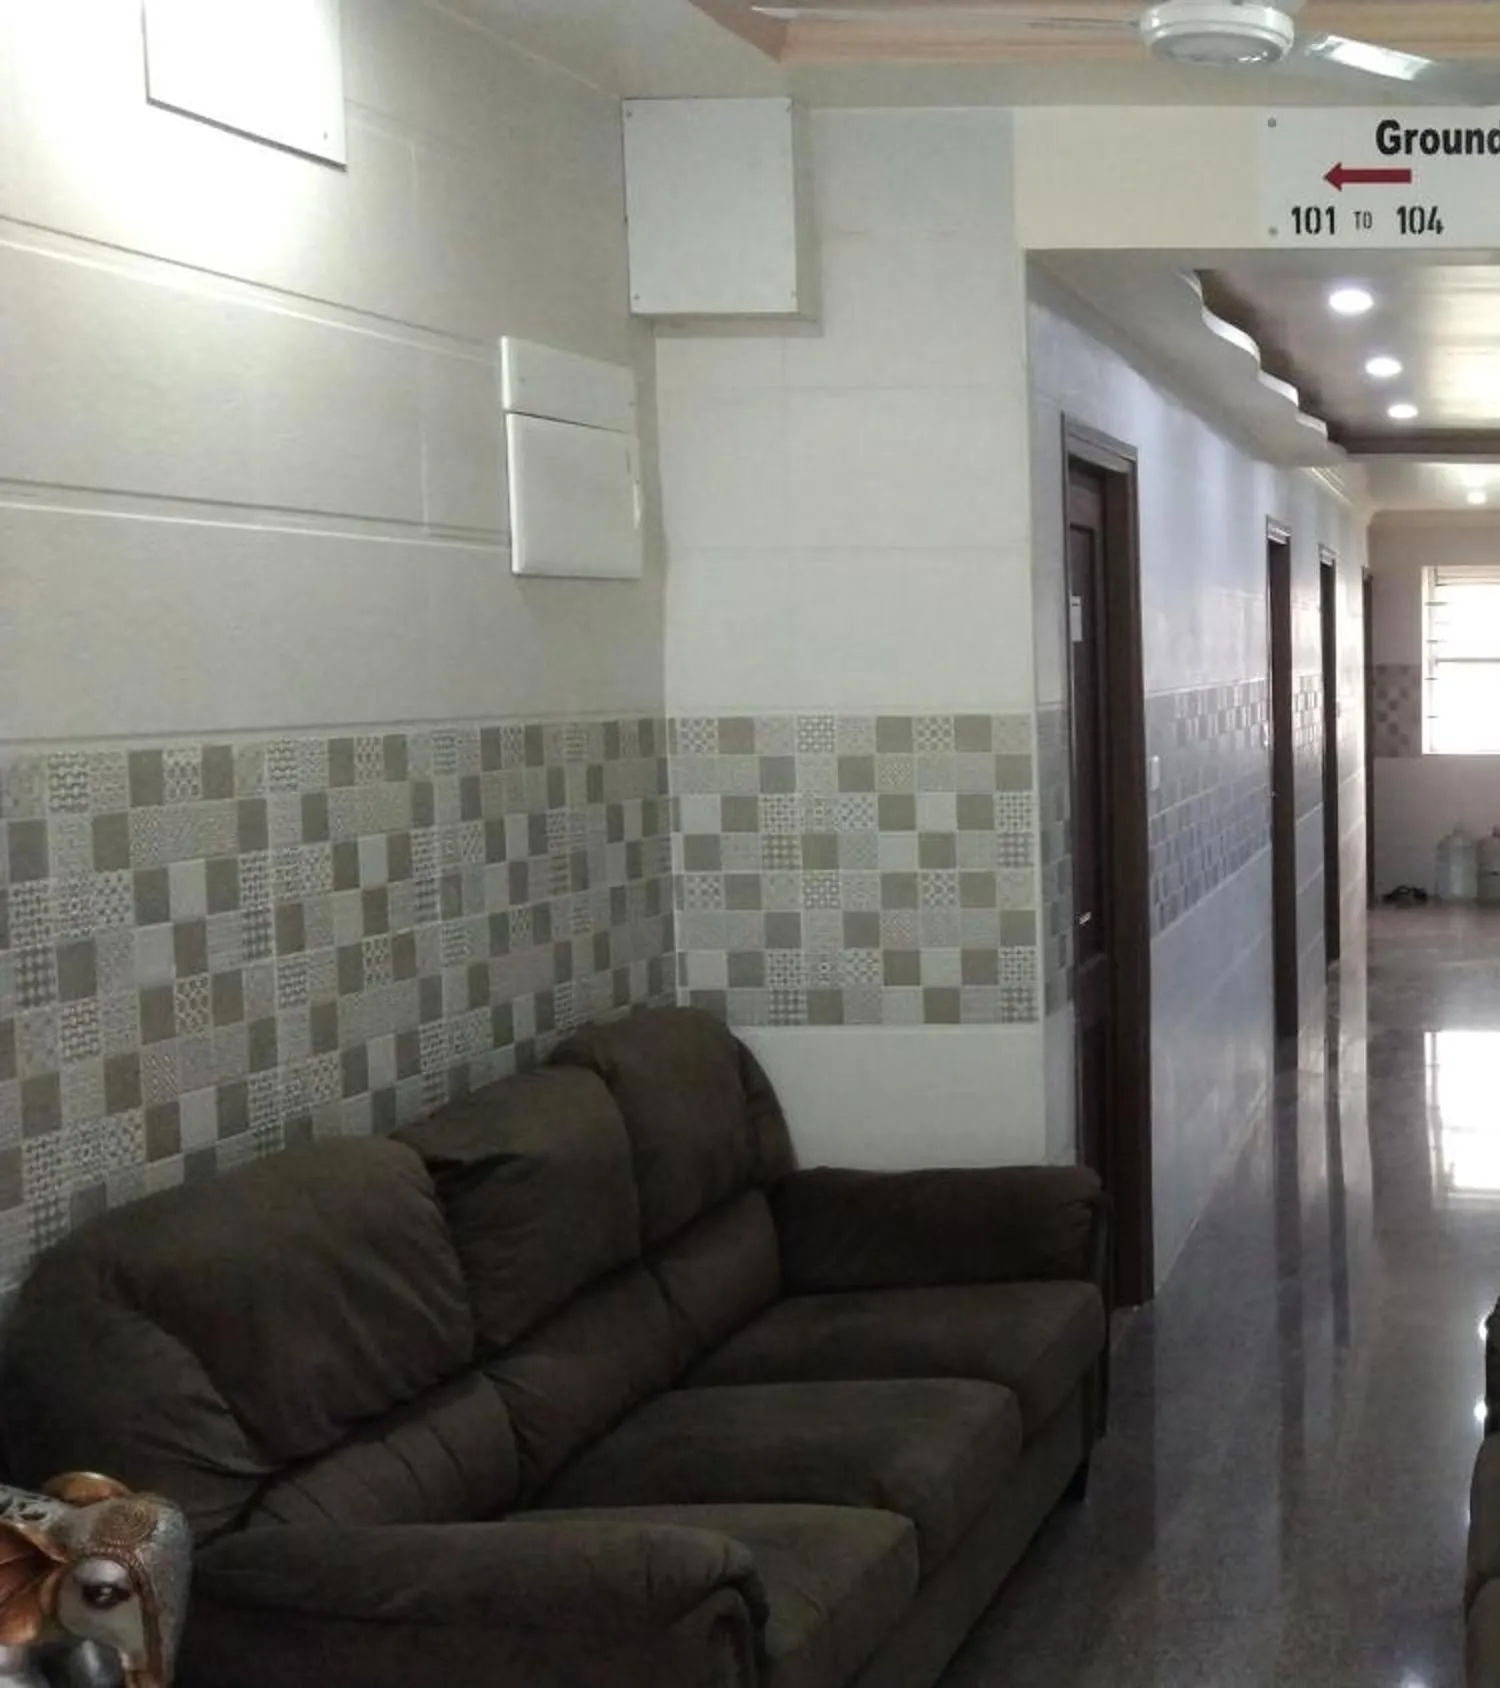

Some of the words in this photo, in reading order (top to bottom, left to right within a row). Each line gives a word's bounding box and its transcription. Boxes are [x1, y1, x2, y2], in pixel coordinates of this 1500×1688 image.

[1290, 205, 1336, 235] 101
[1353, 210, 1373, 230] TO
[1395, 205, 1445, 235] 104
